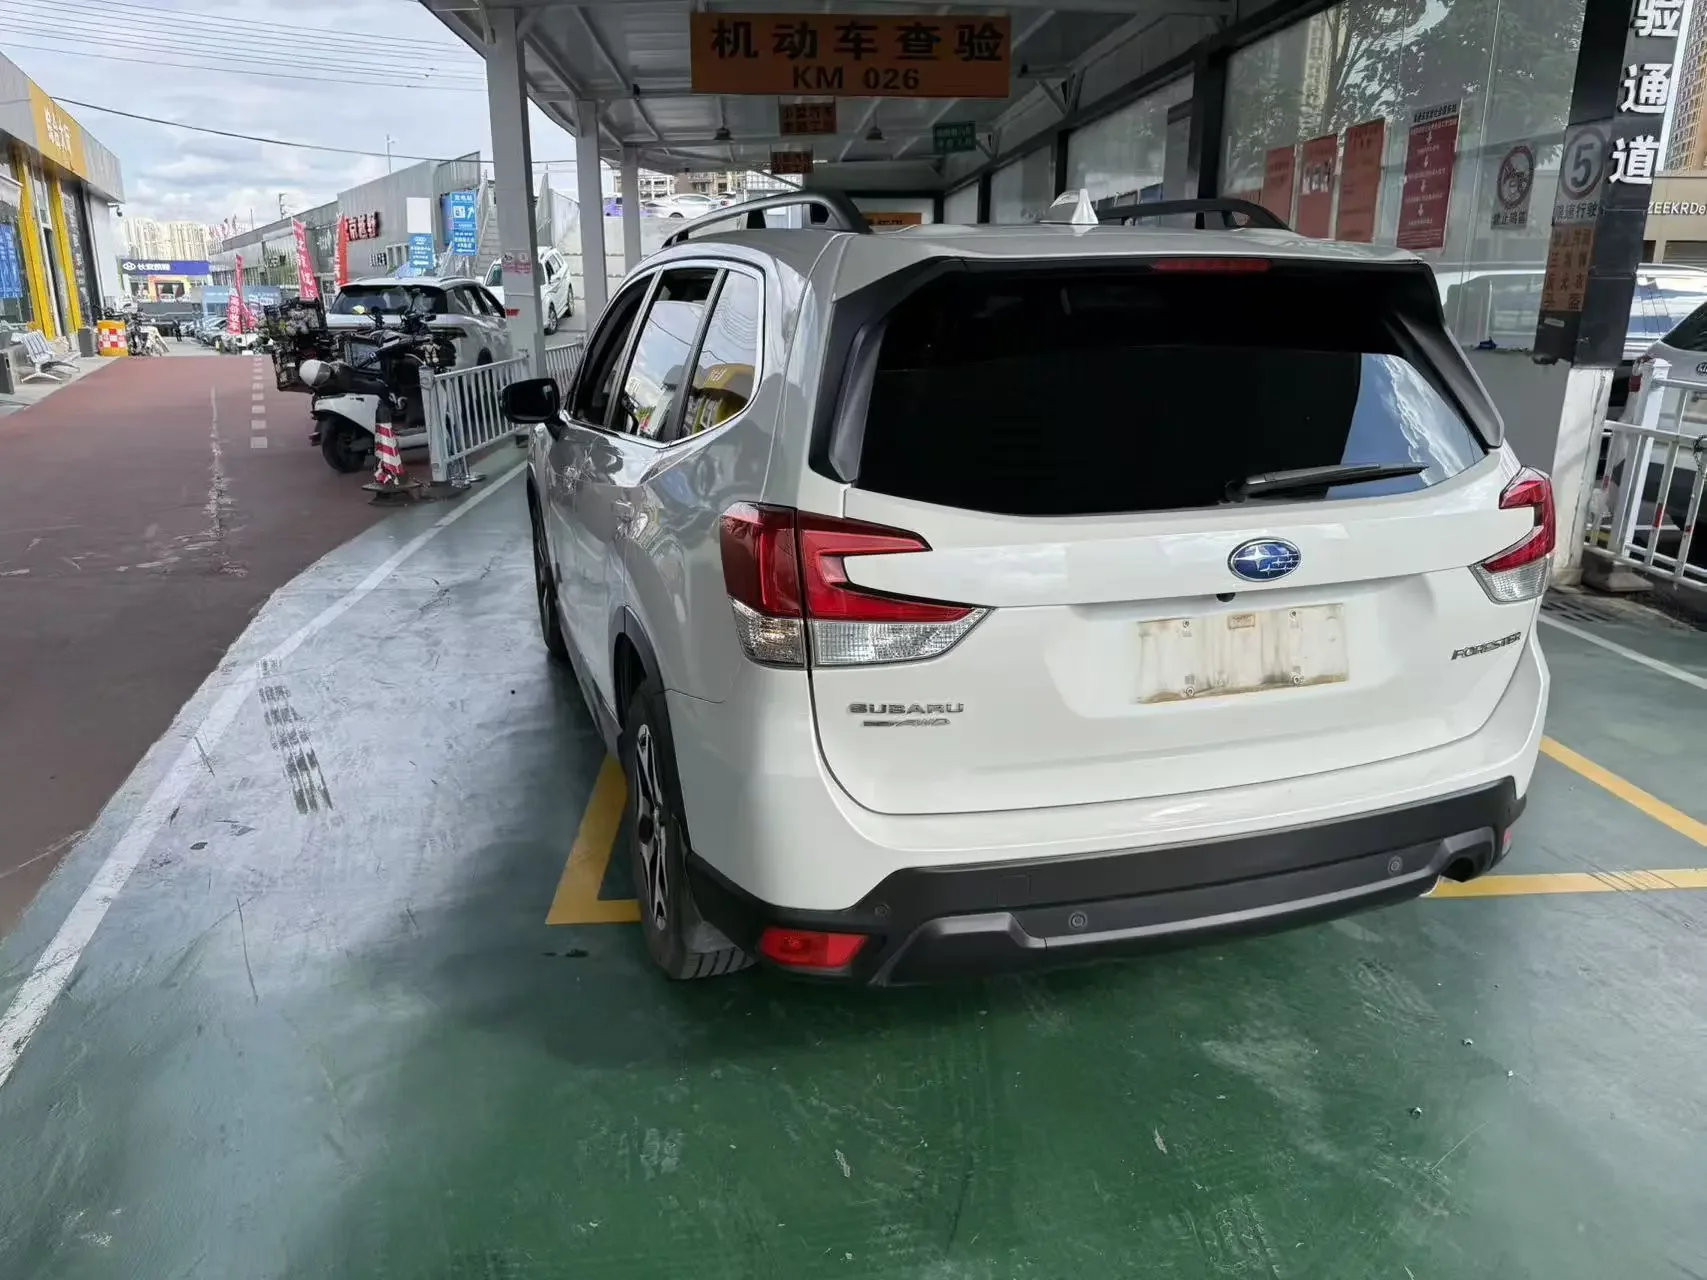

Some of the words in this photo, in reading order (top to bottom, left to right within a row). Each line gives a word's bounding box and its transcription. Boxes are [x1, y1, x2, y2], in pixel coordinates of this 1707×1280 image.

[710, 19, 1005, 61] 机动车查验
[793, 65, 843, 89] KM
[863, 67, 920, 90] 026
[1570, 143, 1595, 188] 5
[1553, 201, 1598, 219] 限速行驶
[1451, 631, 1522, 660] FORESTER
[849, 702, 965, 714] SUBARU
